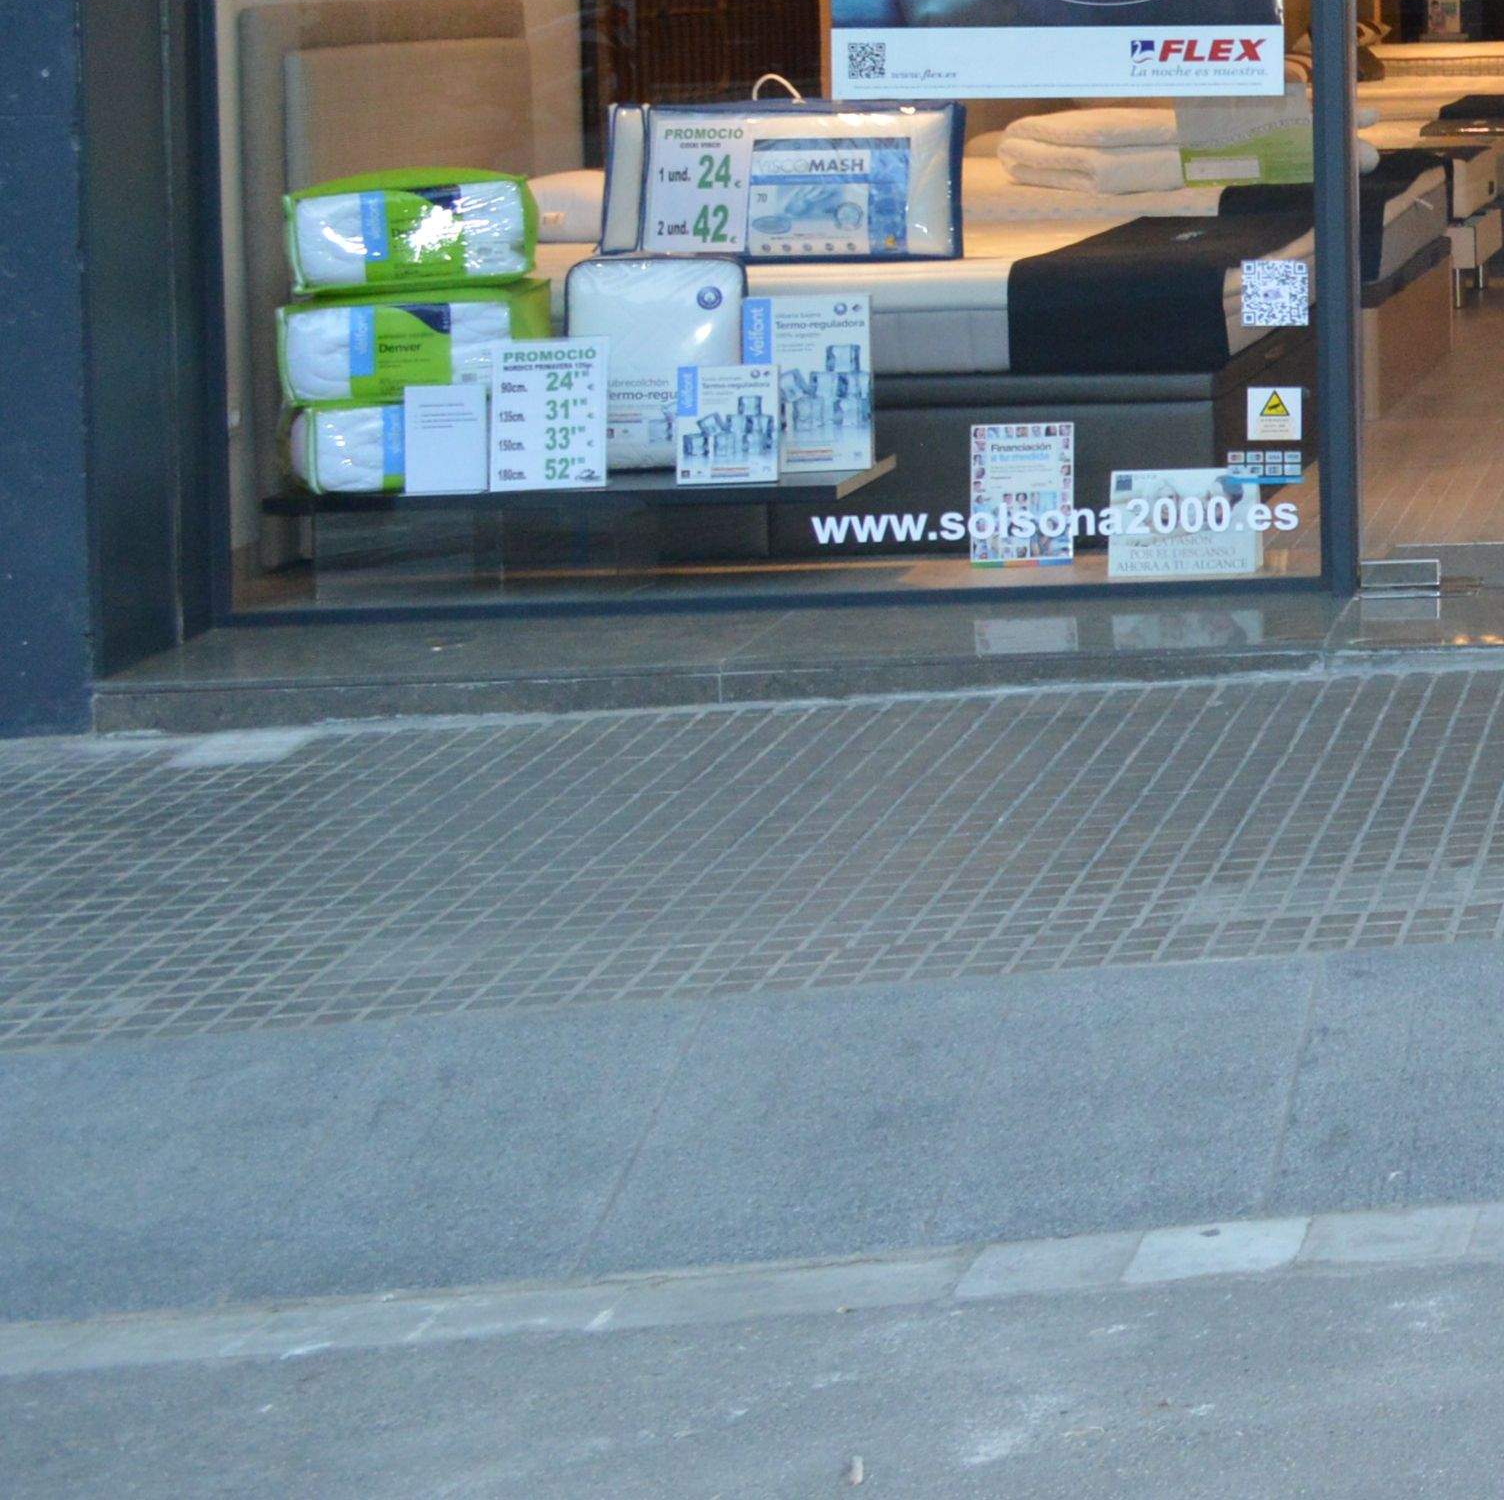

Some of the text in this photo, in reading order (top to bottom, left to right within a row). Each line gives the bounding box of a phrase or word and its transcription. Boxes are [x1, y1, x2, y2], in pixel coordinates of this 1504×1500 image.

[1158, 37, 1268, 63] FLEX
[1130, 65, 1269, 79] La noche es nuestra.
[658, 169, 664, 182] 1
[667, 168, 691, 183] und.
[697, 154, 732, 190] 24
[657, 219, 665, 234] 2
[666, 219, 689, 235] und.
[692, 204, 730, 244] 42
[775, 319, 865, 331] Termo-reguladora
[378, 343, 422, 354] Denver
[503, 346, 597, 362] PROMOCIÓ
[607, 377, 669, 389] ubrecolchón
[607, 389, 678, 403] ermo-regu
[990, 442, 1052, 452] Financiación
[811, 496, 1299, 545] www.solsona2000.es
